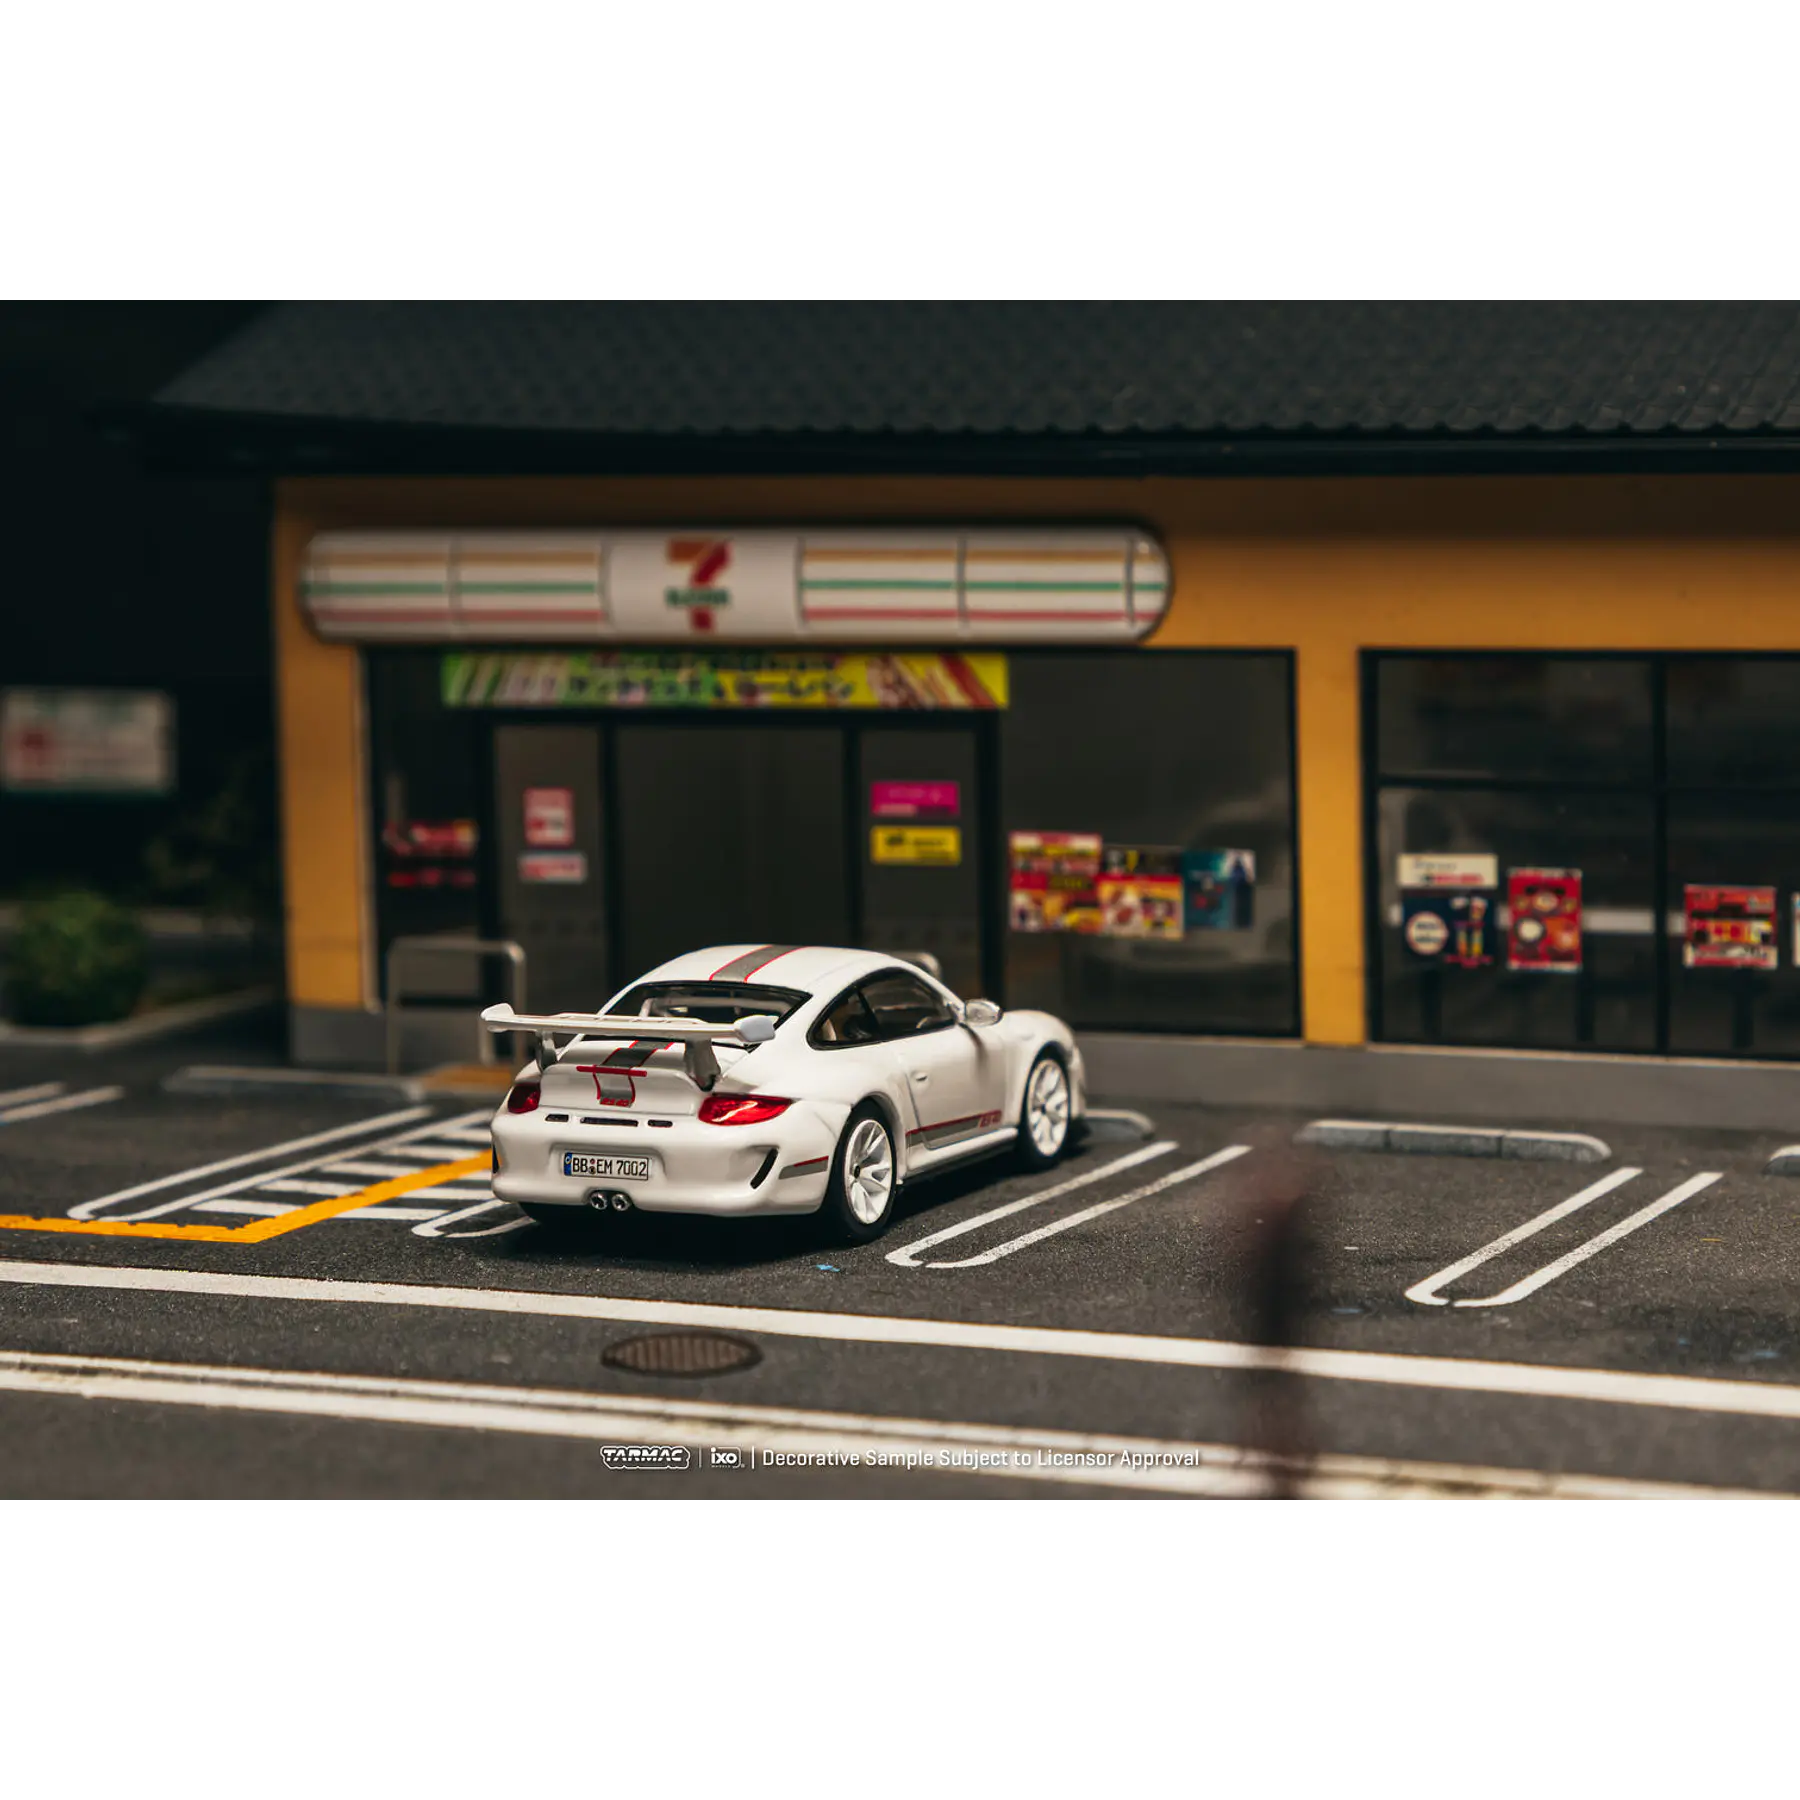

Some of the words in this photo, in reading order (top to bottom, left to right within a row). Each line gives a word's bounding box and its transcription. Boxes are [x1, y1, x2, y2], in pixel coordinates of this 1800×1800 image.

[667, 537, 731, 632] 7
[572, 1158, 588, 1173] BB
[596, 1159, 612, 1174] EM
[616, 1161, 647, 1176] 7002
